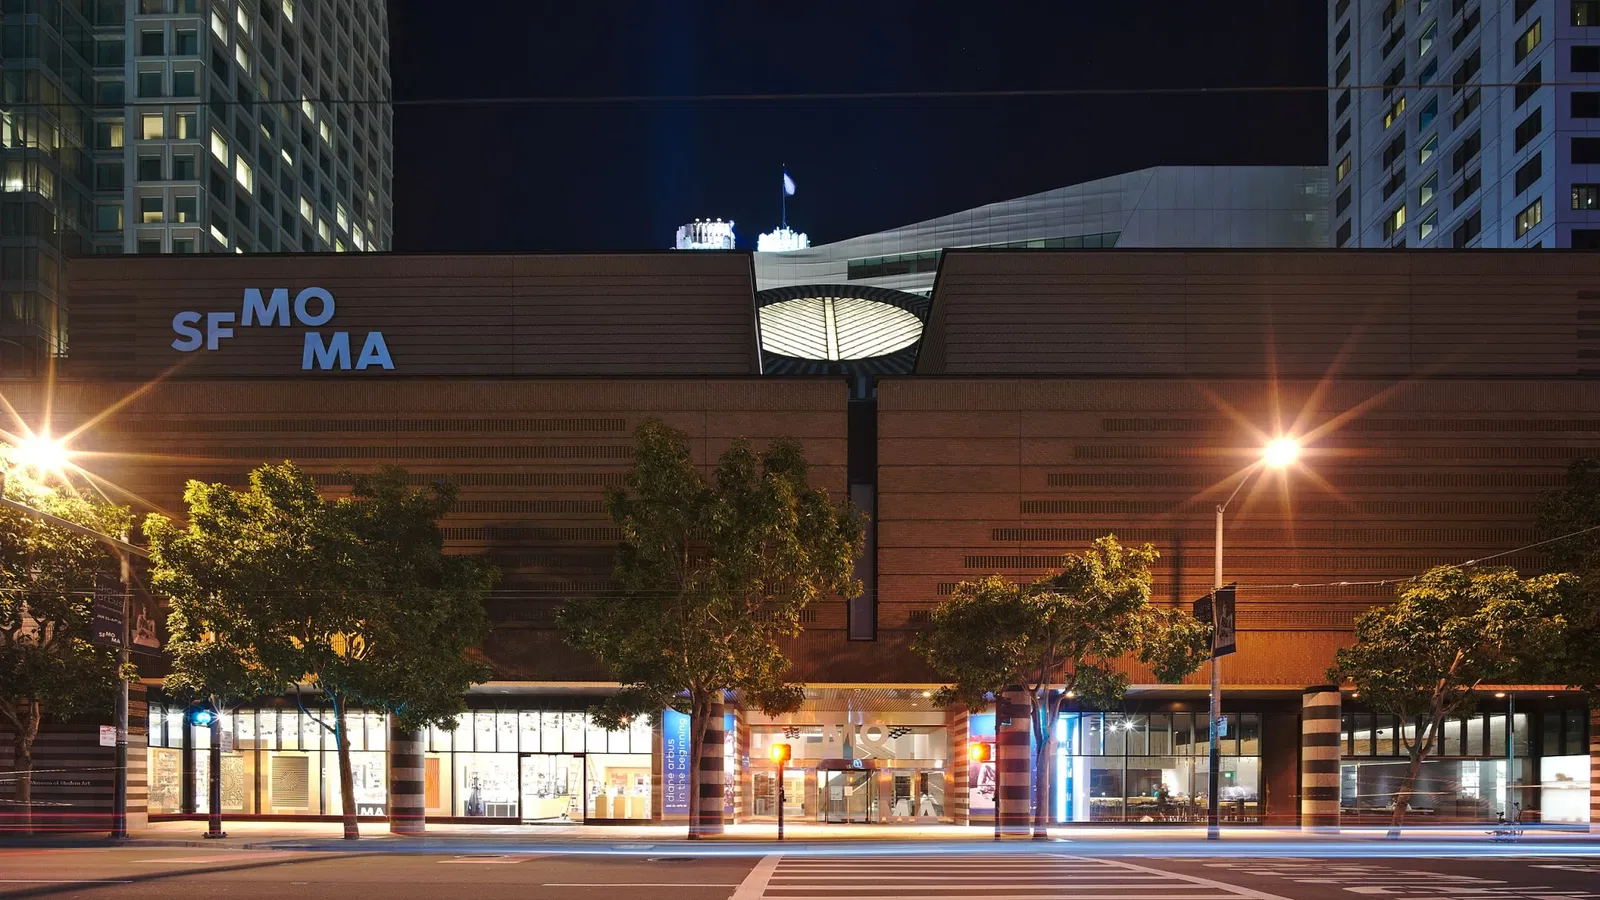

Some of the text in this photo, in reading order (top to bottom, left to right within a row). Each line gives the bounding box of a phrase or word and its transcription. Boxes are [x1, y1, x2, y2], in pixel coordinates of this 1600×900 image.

[171, 286, 336, 352] SF MO
[301, 331, 395, 370] MA
[665, 739, 675, 802] diane arbus
[676, 718, 688, 802] in the beginning
[360, 807, 385, 816] MA
